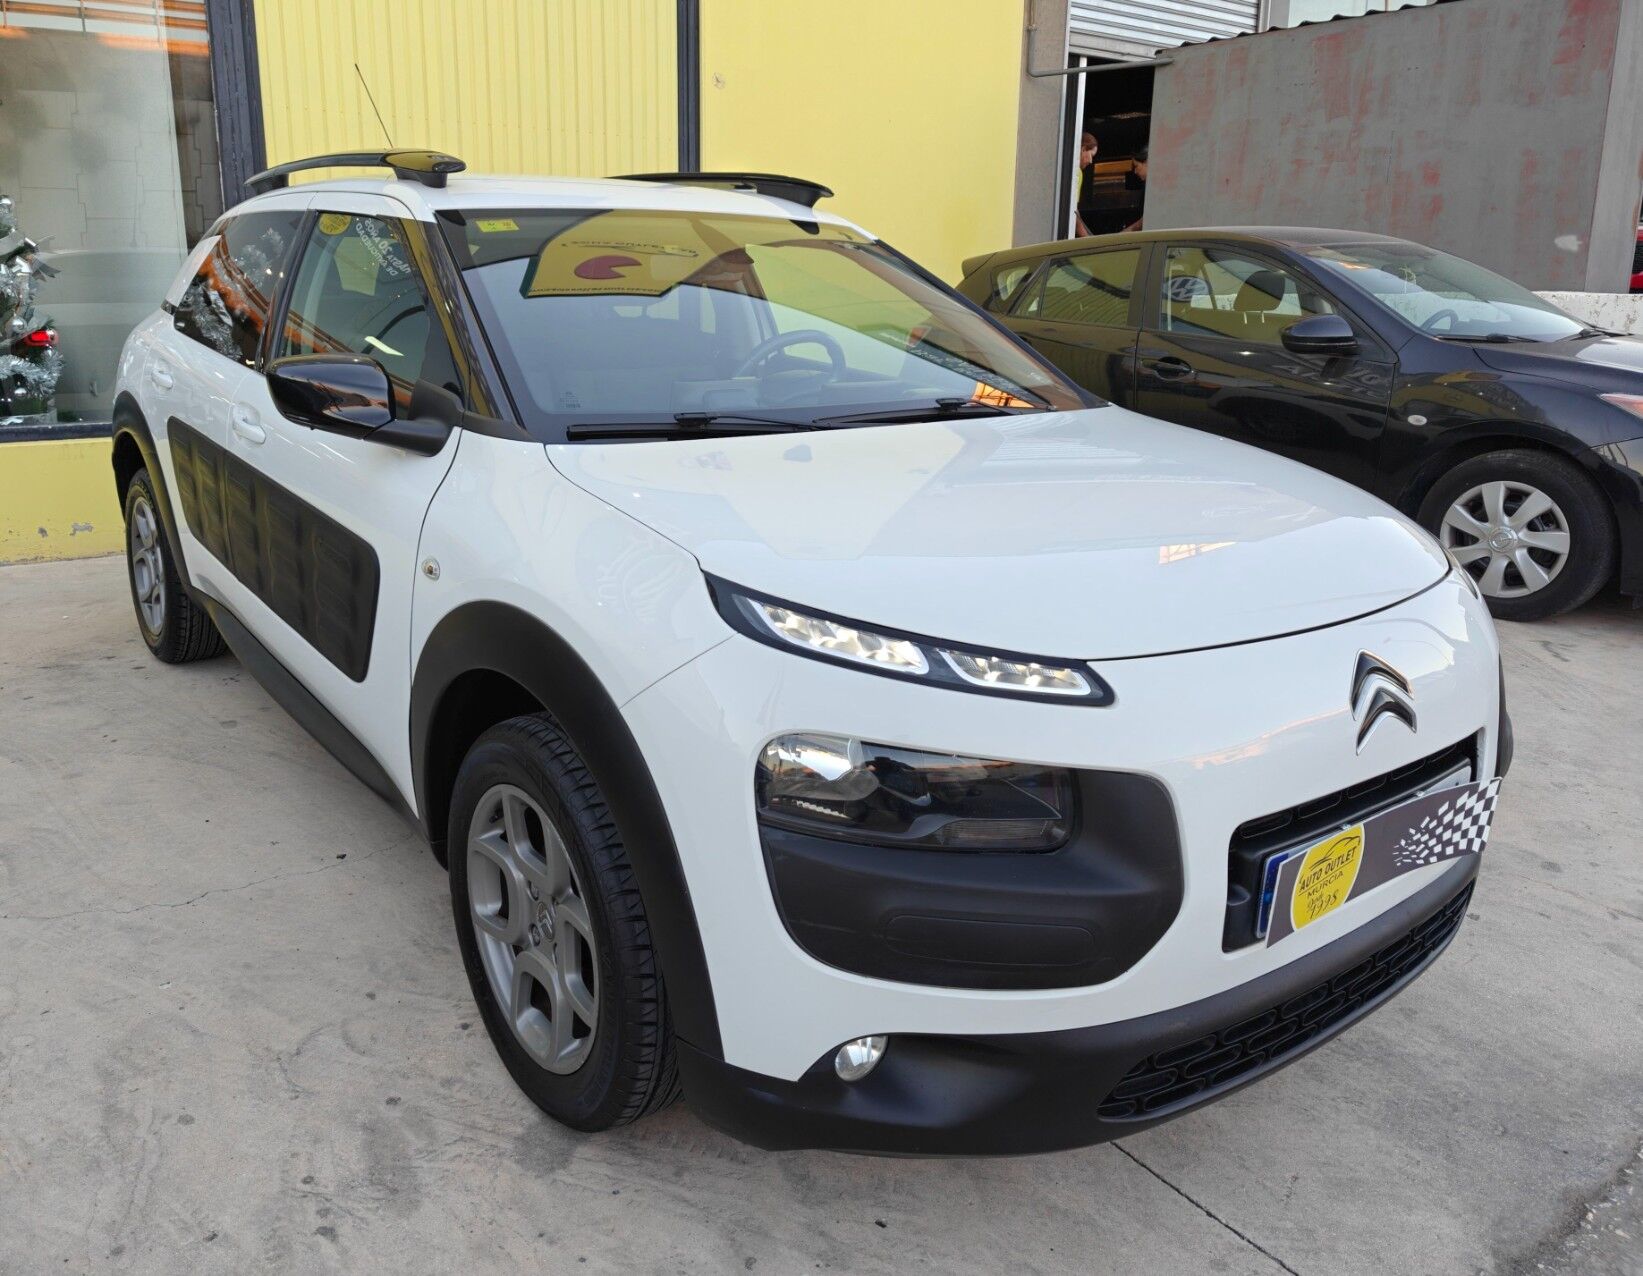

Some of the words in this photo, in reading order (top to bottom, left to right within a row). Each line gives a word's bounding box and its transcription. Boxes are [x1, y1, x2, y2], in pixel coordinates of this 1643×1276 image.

[1299, 868, 1322, 892] AUTO
[1324, 846, 1357, 875] OUTLET
[1307, 870, 1344, 899] MURCIA
